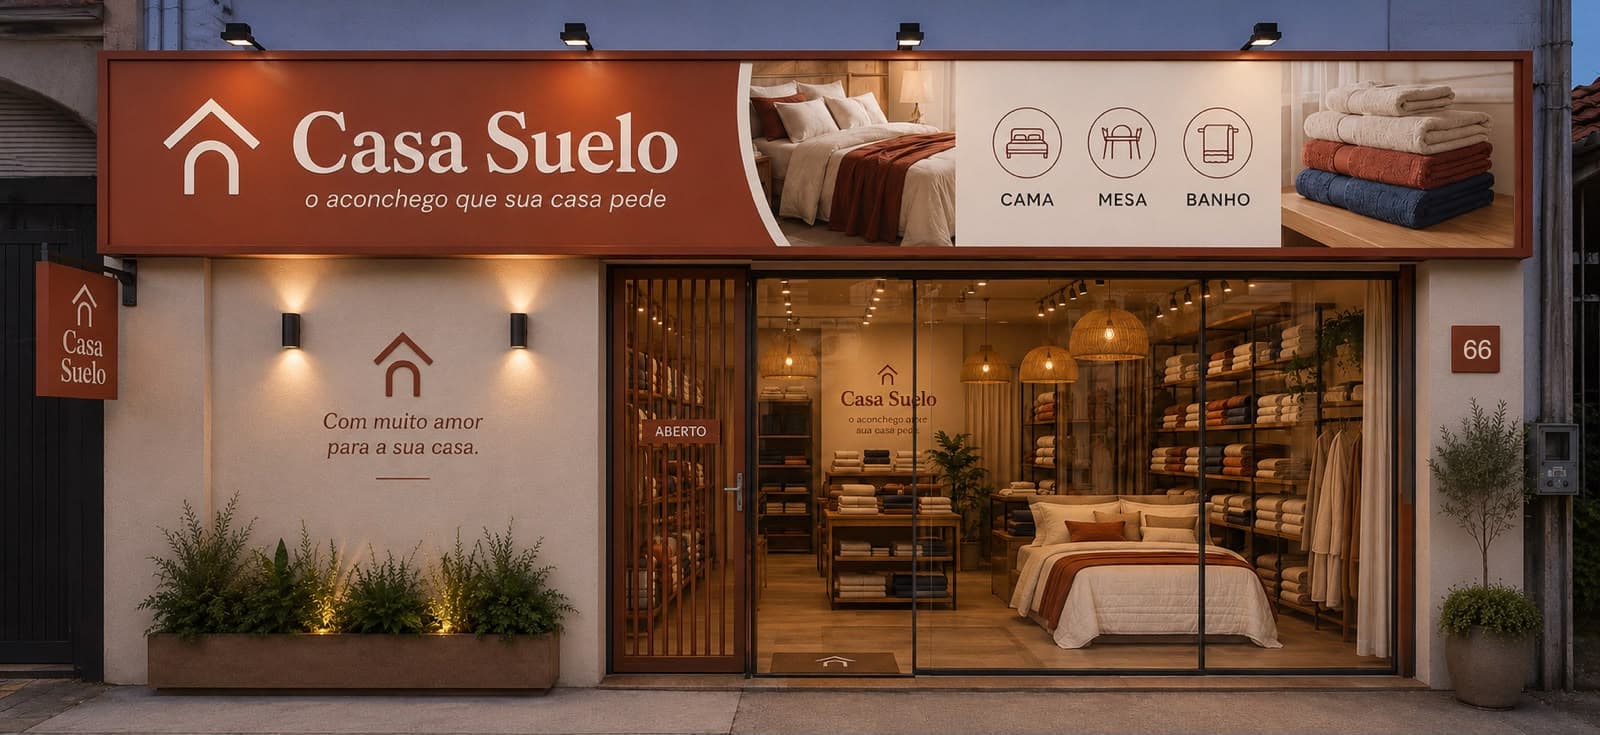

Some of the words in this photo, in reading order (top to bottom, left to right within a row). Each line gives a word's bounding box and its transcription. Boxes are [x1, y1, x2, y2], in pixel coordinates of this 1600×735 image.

[293, 111, 467, 173] Casa
[487, 111, 678, 173] Suelo
[306, 194, 318, 207] o
[327, 189, 447, 212] aconchego
[456, 194, 496, 212] que
[505, 194, 542, 207] sua
[551, 194, 601, 207] casa
[610, 189, 666, 212] pede
[1001, 193, 1053, 206] CAMA
[1099, 193, 1147, 206] MESA
[1187, 193, 1250, 206] BANHO
[63, 330, 103, 357] Casa
[1464, 340, 1491, 359] 66
[61, 358, 105, 384] Suelo
[841, 391, 883, 407] Casa
[324, 413, 366, 429] Com
[374, 413, 427, 429] muito
[434, 417, 483, 429] amor
[856, 416, 904, 426] aconchego
[656, 425, 706, 437] ABERTO
[328, 443, 368, 459] para
[376, 443, 386, 454] a
[393, 443, 424, 454] sua
[432, 443, 478, 454] casa.
